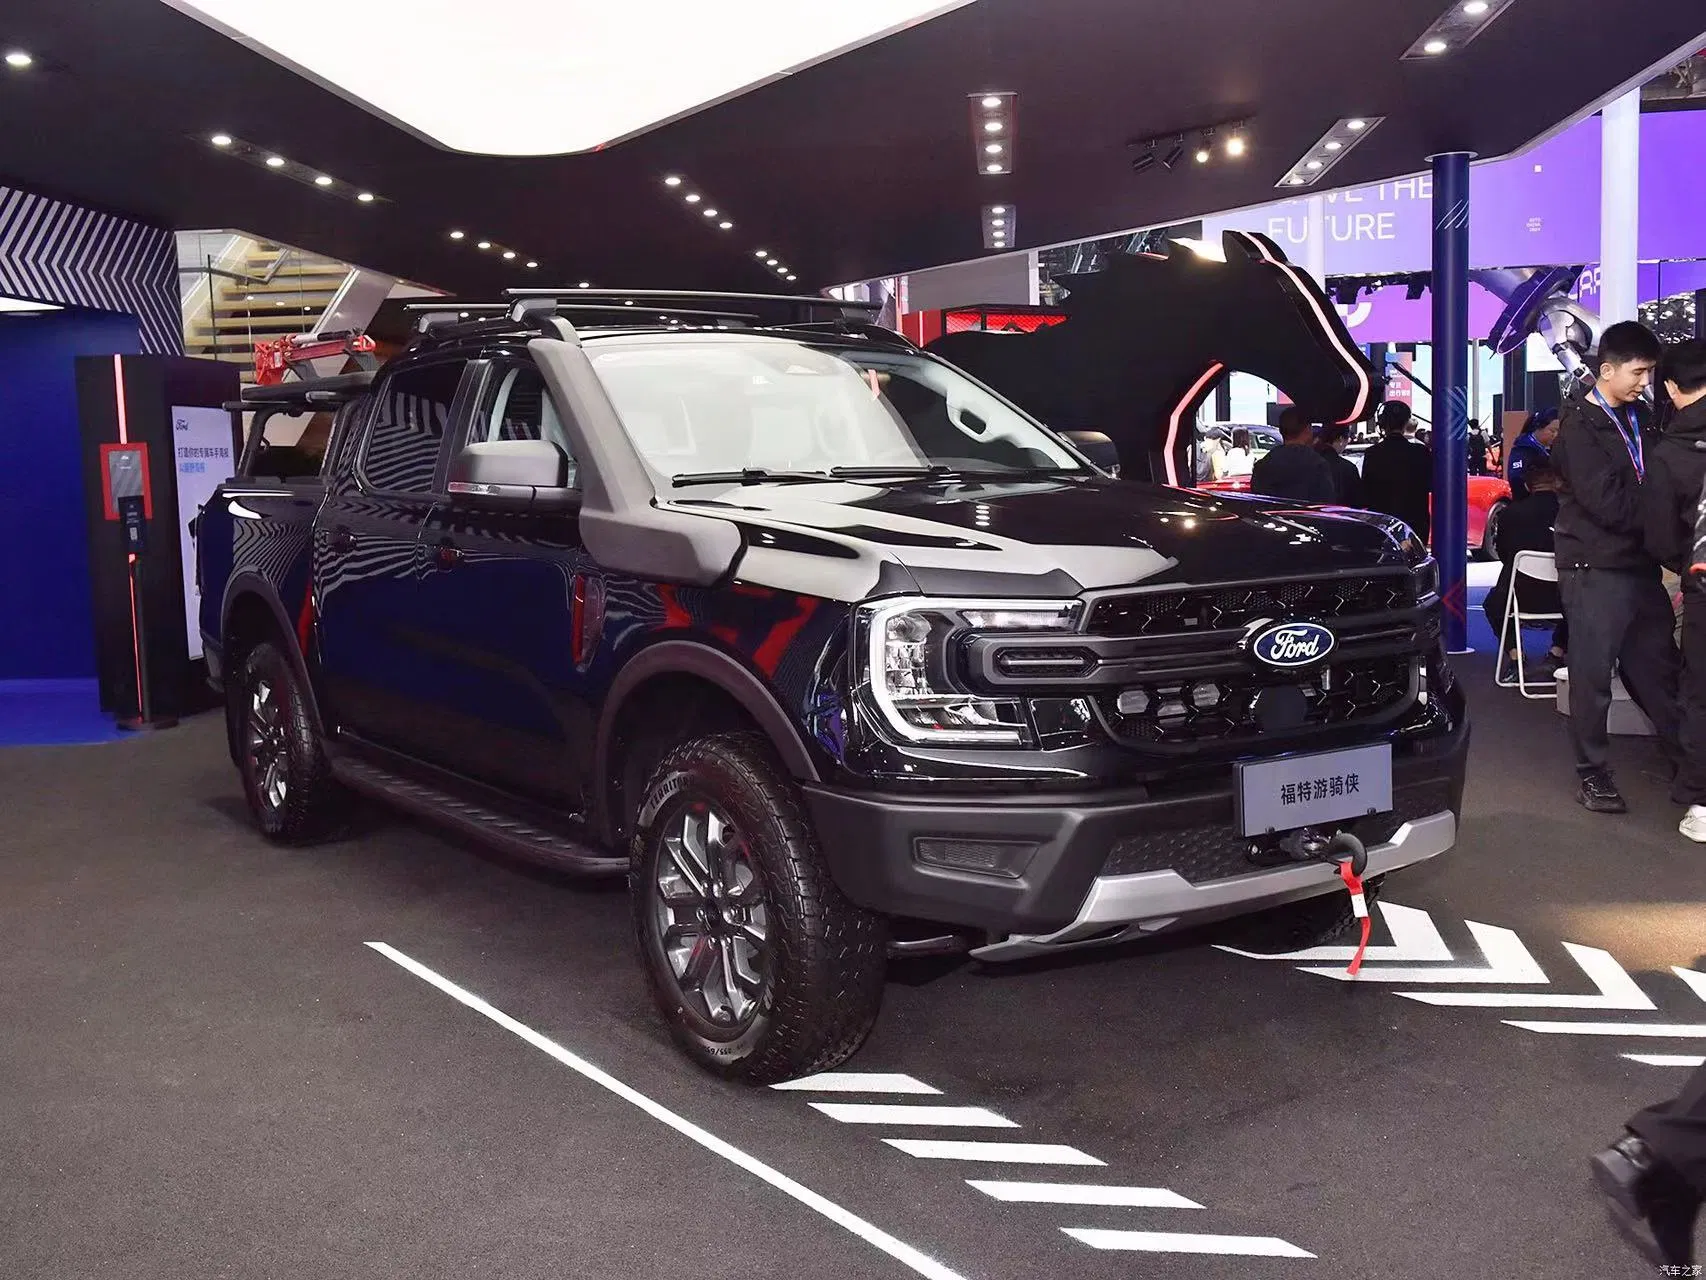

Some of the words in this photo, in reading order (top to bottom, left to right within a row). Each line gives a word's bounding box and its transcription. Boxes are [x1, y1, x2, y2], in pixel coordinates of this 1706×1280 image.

[1268, 212, 1395, 243] FUURE
[1270, 629, 1320, 660] Ford
[1280, 773, 1361, 806] 福特游骑侠
